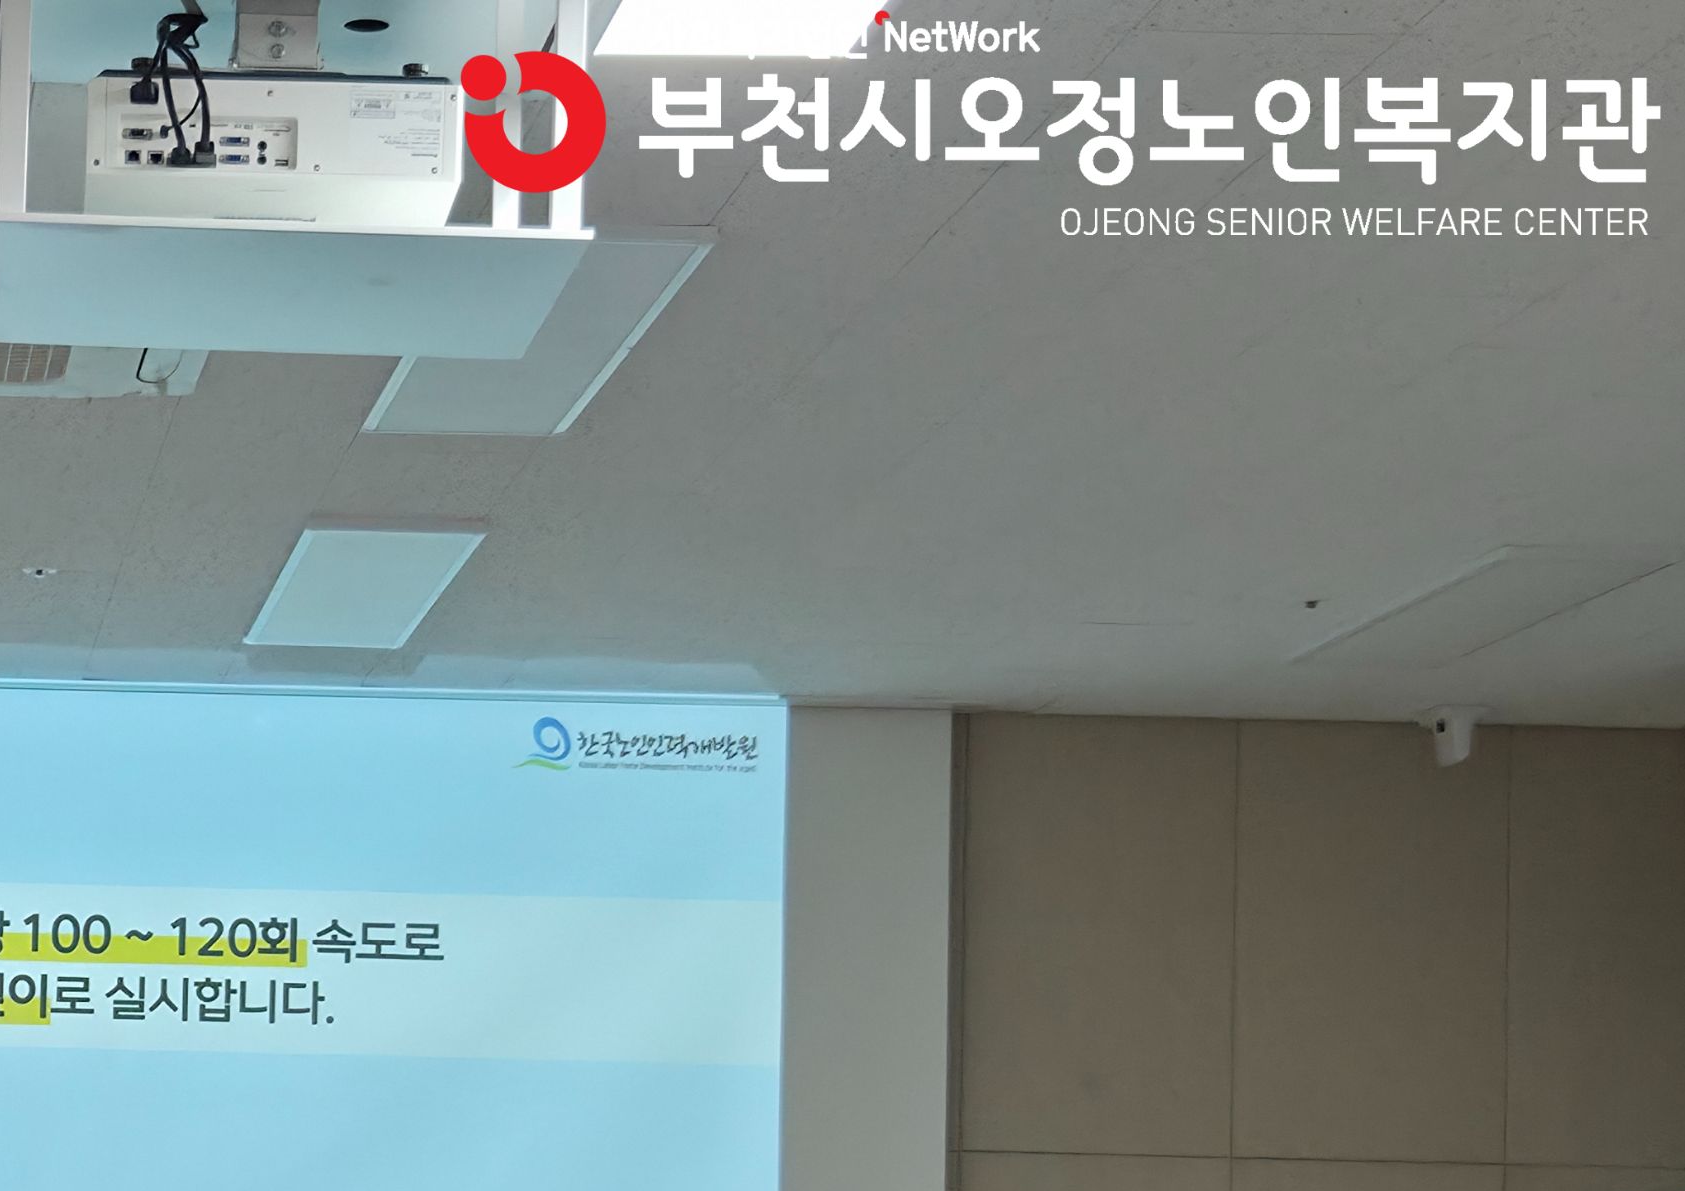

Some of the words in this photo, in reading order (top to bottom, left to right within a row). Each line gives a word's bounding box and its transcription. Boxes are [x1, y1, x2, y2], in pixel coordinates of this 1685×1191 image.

[576, 730, 758, 760] 한국노인인력개발원
[23, 913, 113, 955] 100
[170, 917, 299, 963] 120회
[312, 919, 445, 965] 속도로
[105, 976, 335, 1025] 실시합니다.
